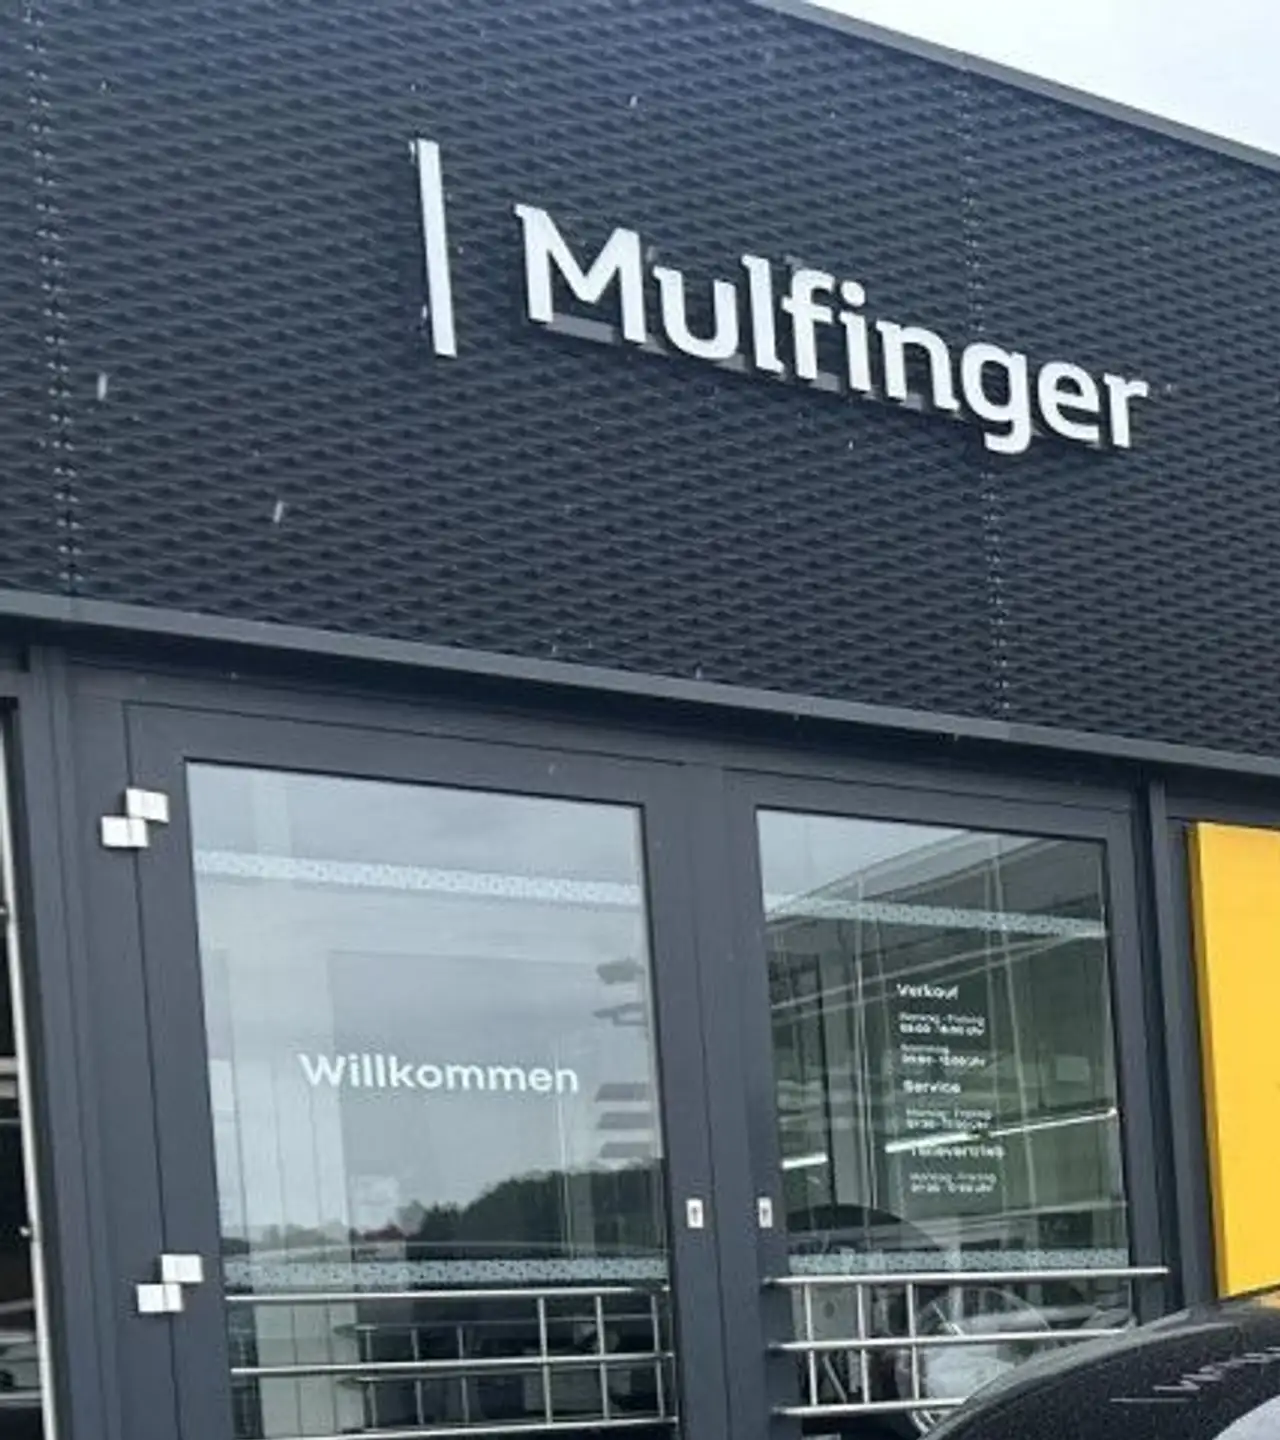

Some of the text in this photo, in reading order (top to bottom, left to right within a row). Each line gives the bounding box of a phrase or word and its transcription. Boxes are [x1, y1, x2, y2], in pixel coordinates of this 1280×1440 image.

[513, 203, 1150, 455] Mulfinger
[897, 983, 959, 999] Verkauf
[297, 1053, 579, 1093] Willkommen
[903, 1080, 961, 1093] Service
